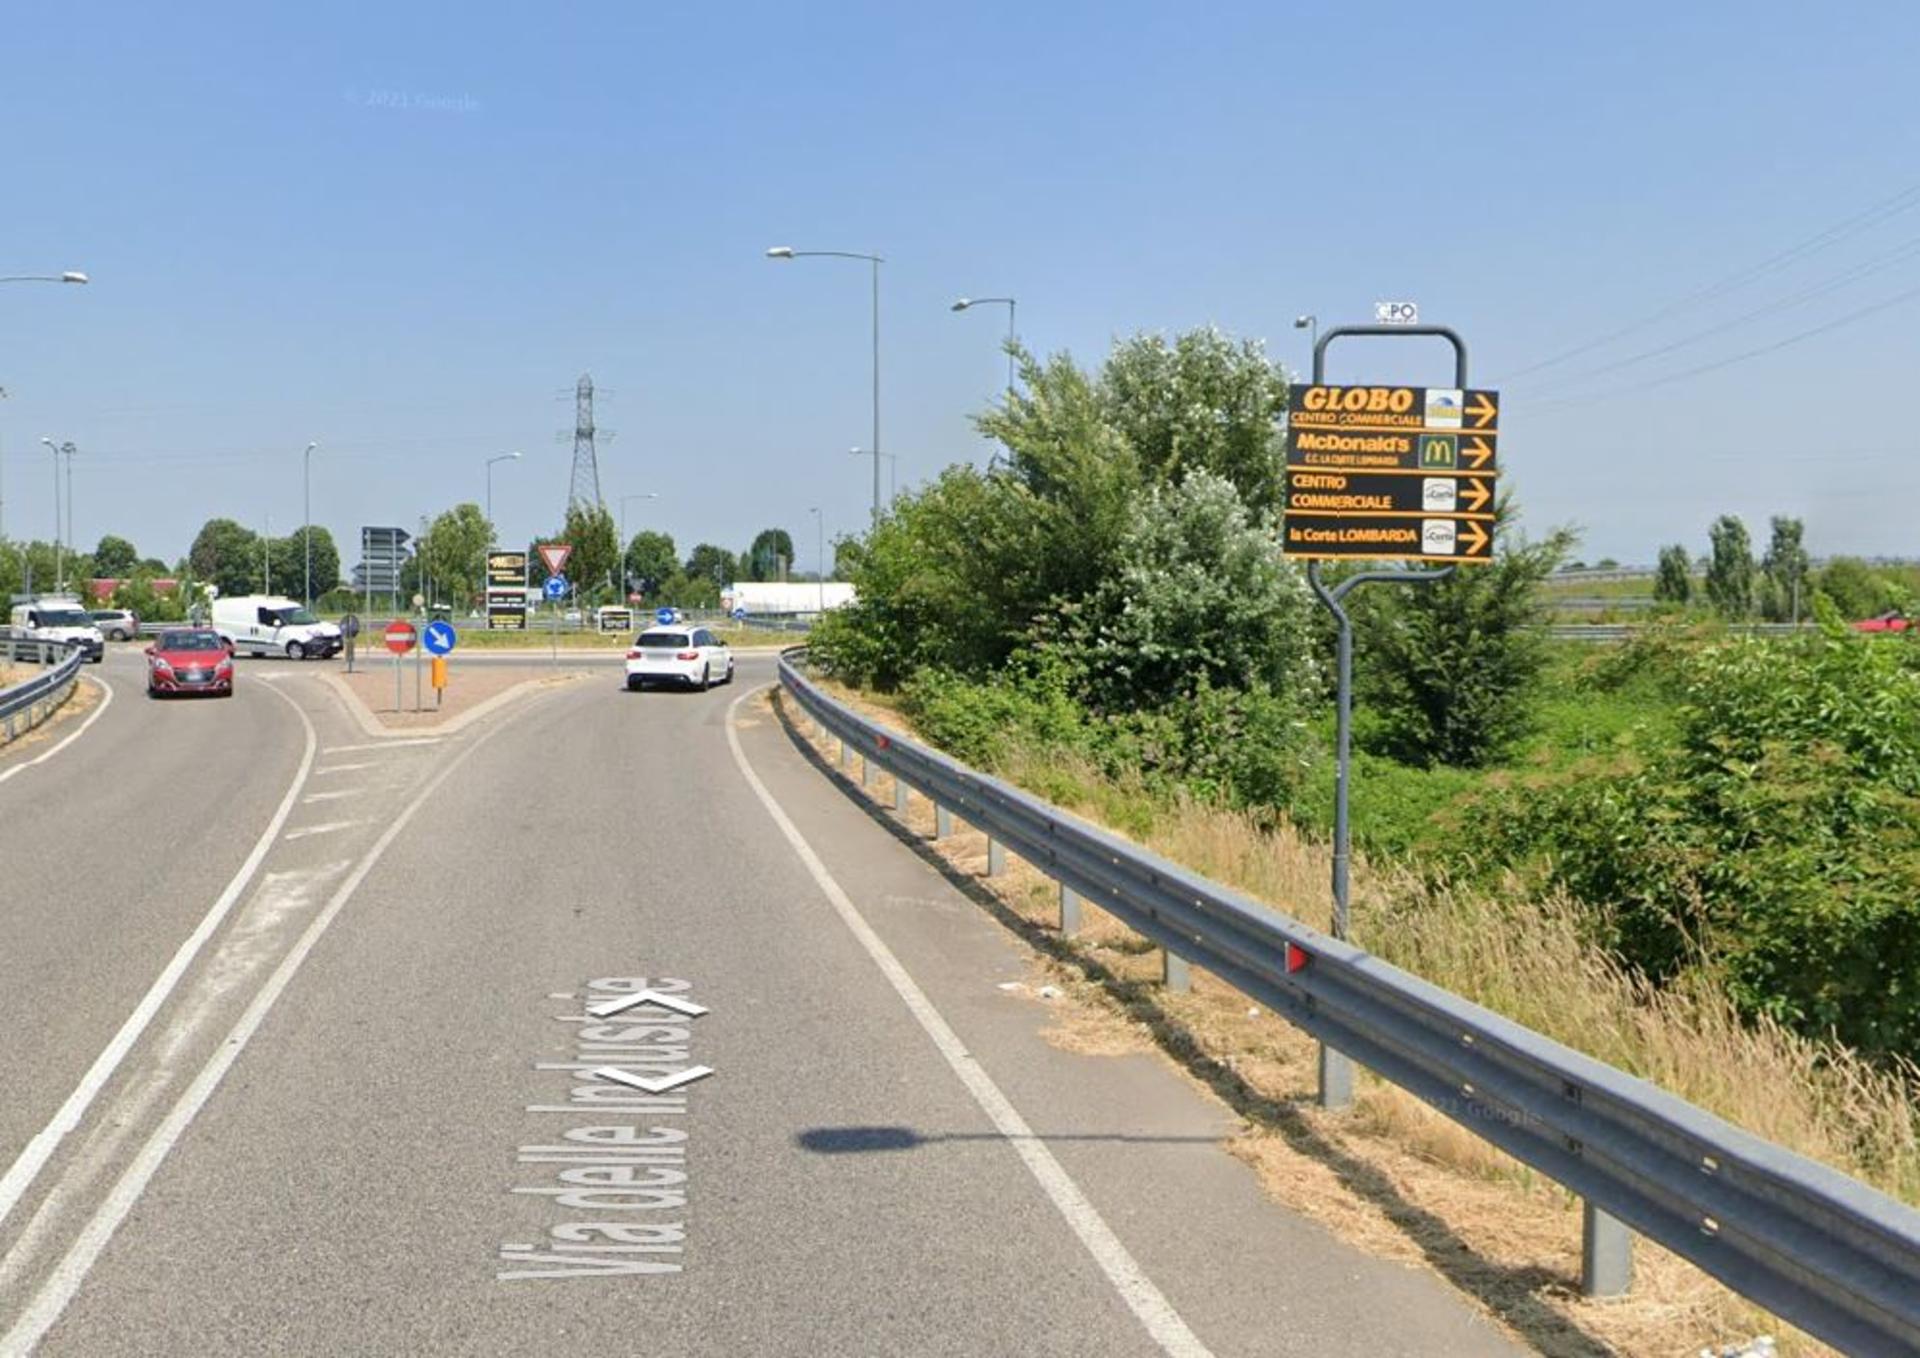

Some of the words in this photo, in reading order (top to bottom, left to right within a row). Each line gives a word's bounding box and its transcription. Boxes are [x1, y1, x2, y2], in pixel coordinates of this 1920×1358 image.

[1303, 386, 1414, 413] GLOBO
[1291, 411, 1337, 423] CENTRO
[1339, 412, 1422, 426] COMMERCIALE
[1297, 433, 1410, 453] McDonald's
[1292, 474, 1347, 490] CENTRO
[1291, 494, 1393, 509] COMMERCIALE
[1290, 527, 1301, 541] la
[1303, 528, 1337, 542] Corte
[1339, 528, 1417, 542] LOMBARDA
